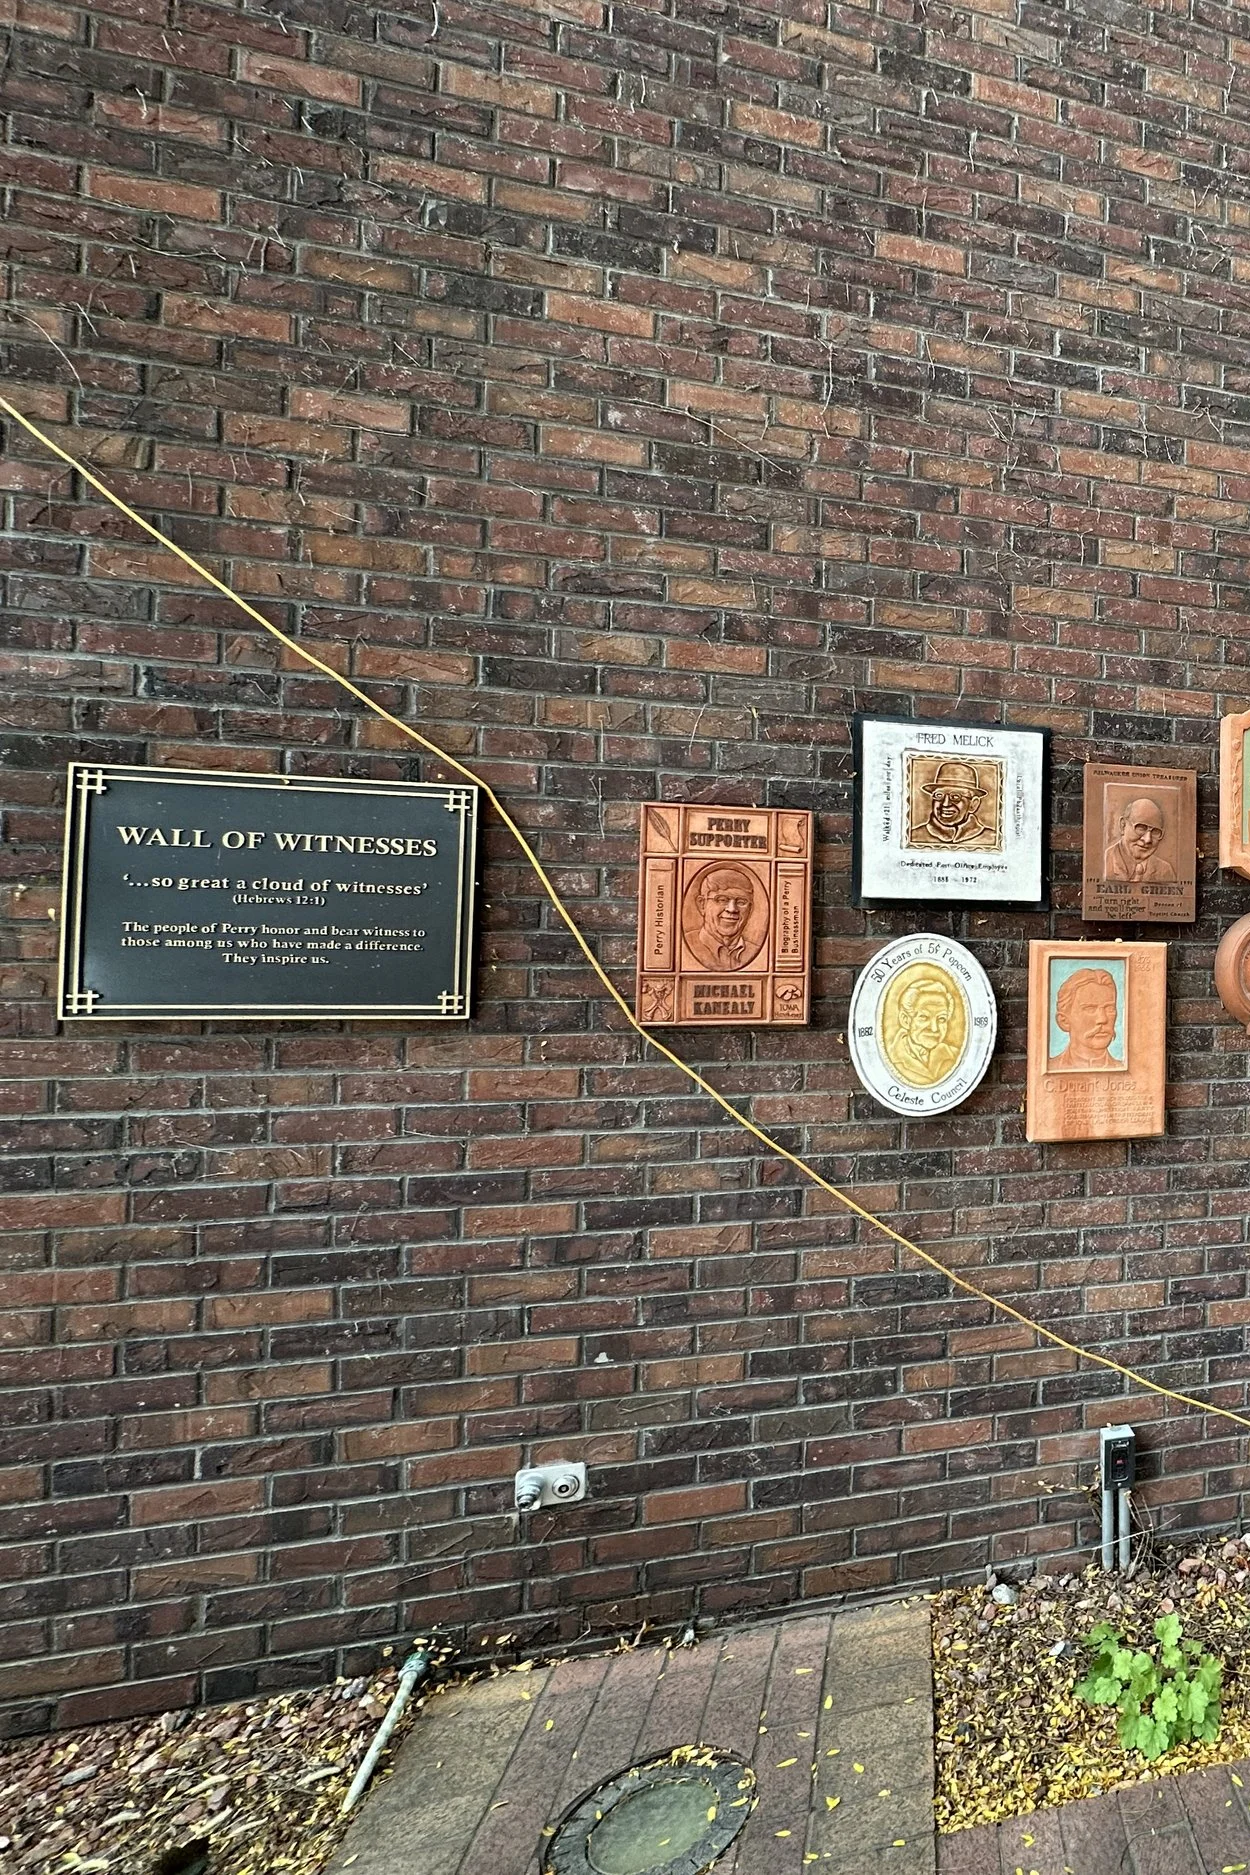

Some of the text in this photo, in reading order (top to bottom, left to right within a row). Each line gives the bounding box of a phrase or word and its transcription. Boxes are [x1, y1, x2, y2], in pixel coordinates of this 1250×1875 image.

[916, 733, 994, 748] FRED MELICK
[707, 817, 751, 832] PERRY
[117, 826, 438, 857] WALL OF WITNESSES
[689, 833, 767, 849] SUPPORTER
[178, 876, 229, 892] great
[236, 880, 247, 890] a
[252, 877, 303, 892] cloud
[310, 879, 329, 892] of
[782, 880, 792, 900] Perry
[1096, 884, 1184, 896] EARL GREEN
[232, 894, 326, 907] (Hebrews 12:1)
[653, 884, 666, 955] Perry Historian
[782, 907, 790, 916] of
[122, 922, 426, 938] The people of Perry honor and bear witness to
[781, 918, 791, 953] Biography
[791, 905, 800, 954] Businessman
[121, 936, 424, 952] those among us who have made a difference.
[222, 953, 330, 967] They inspire us.
[871, 968, 885, 983] 50
[881, 950, 912, 970] Years
[914, 944, 924, 955] of
[942, 948, 972, 982] Popcorn
[693, 984, 755, 999] MICHAEL
[693, 1001, 755, 1016] KANEALY
[779, 1003, 799, 1013] IOWA
[887, 1077, 968, 1106] Celeste Council
[1103, 1077, 1137, 1092] Jones
